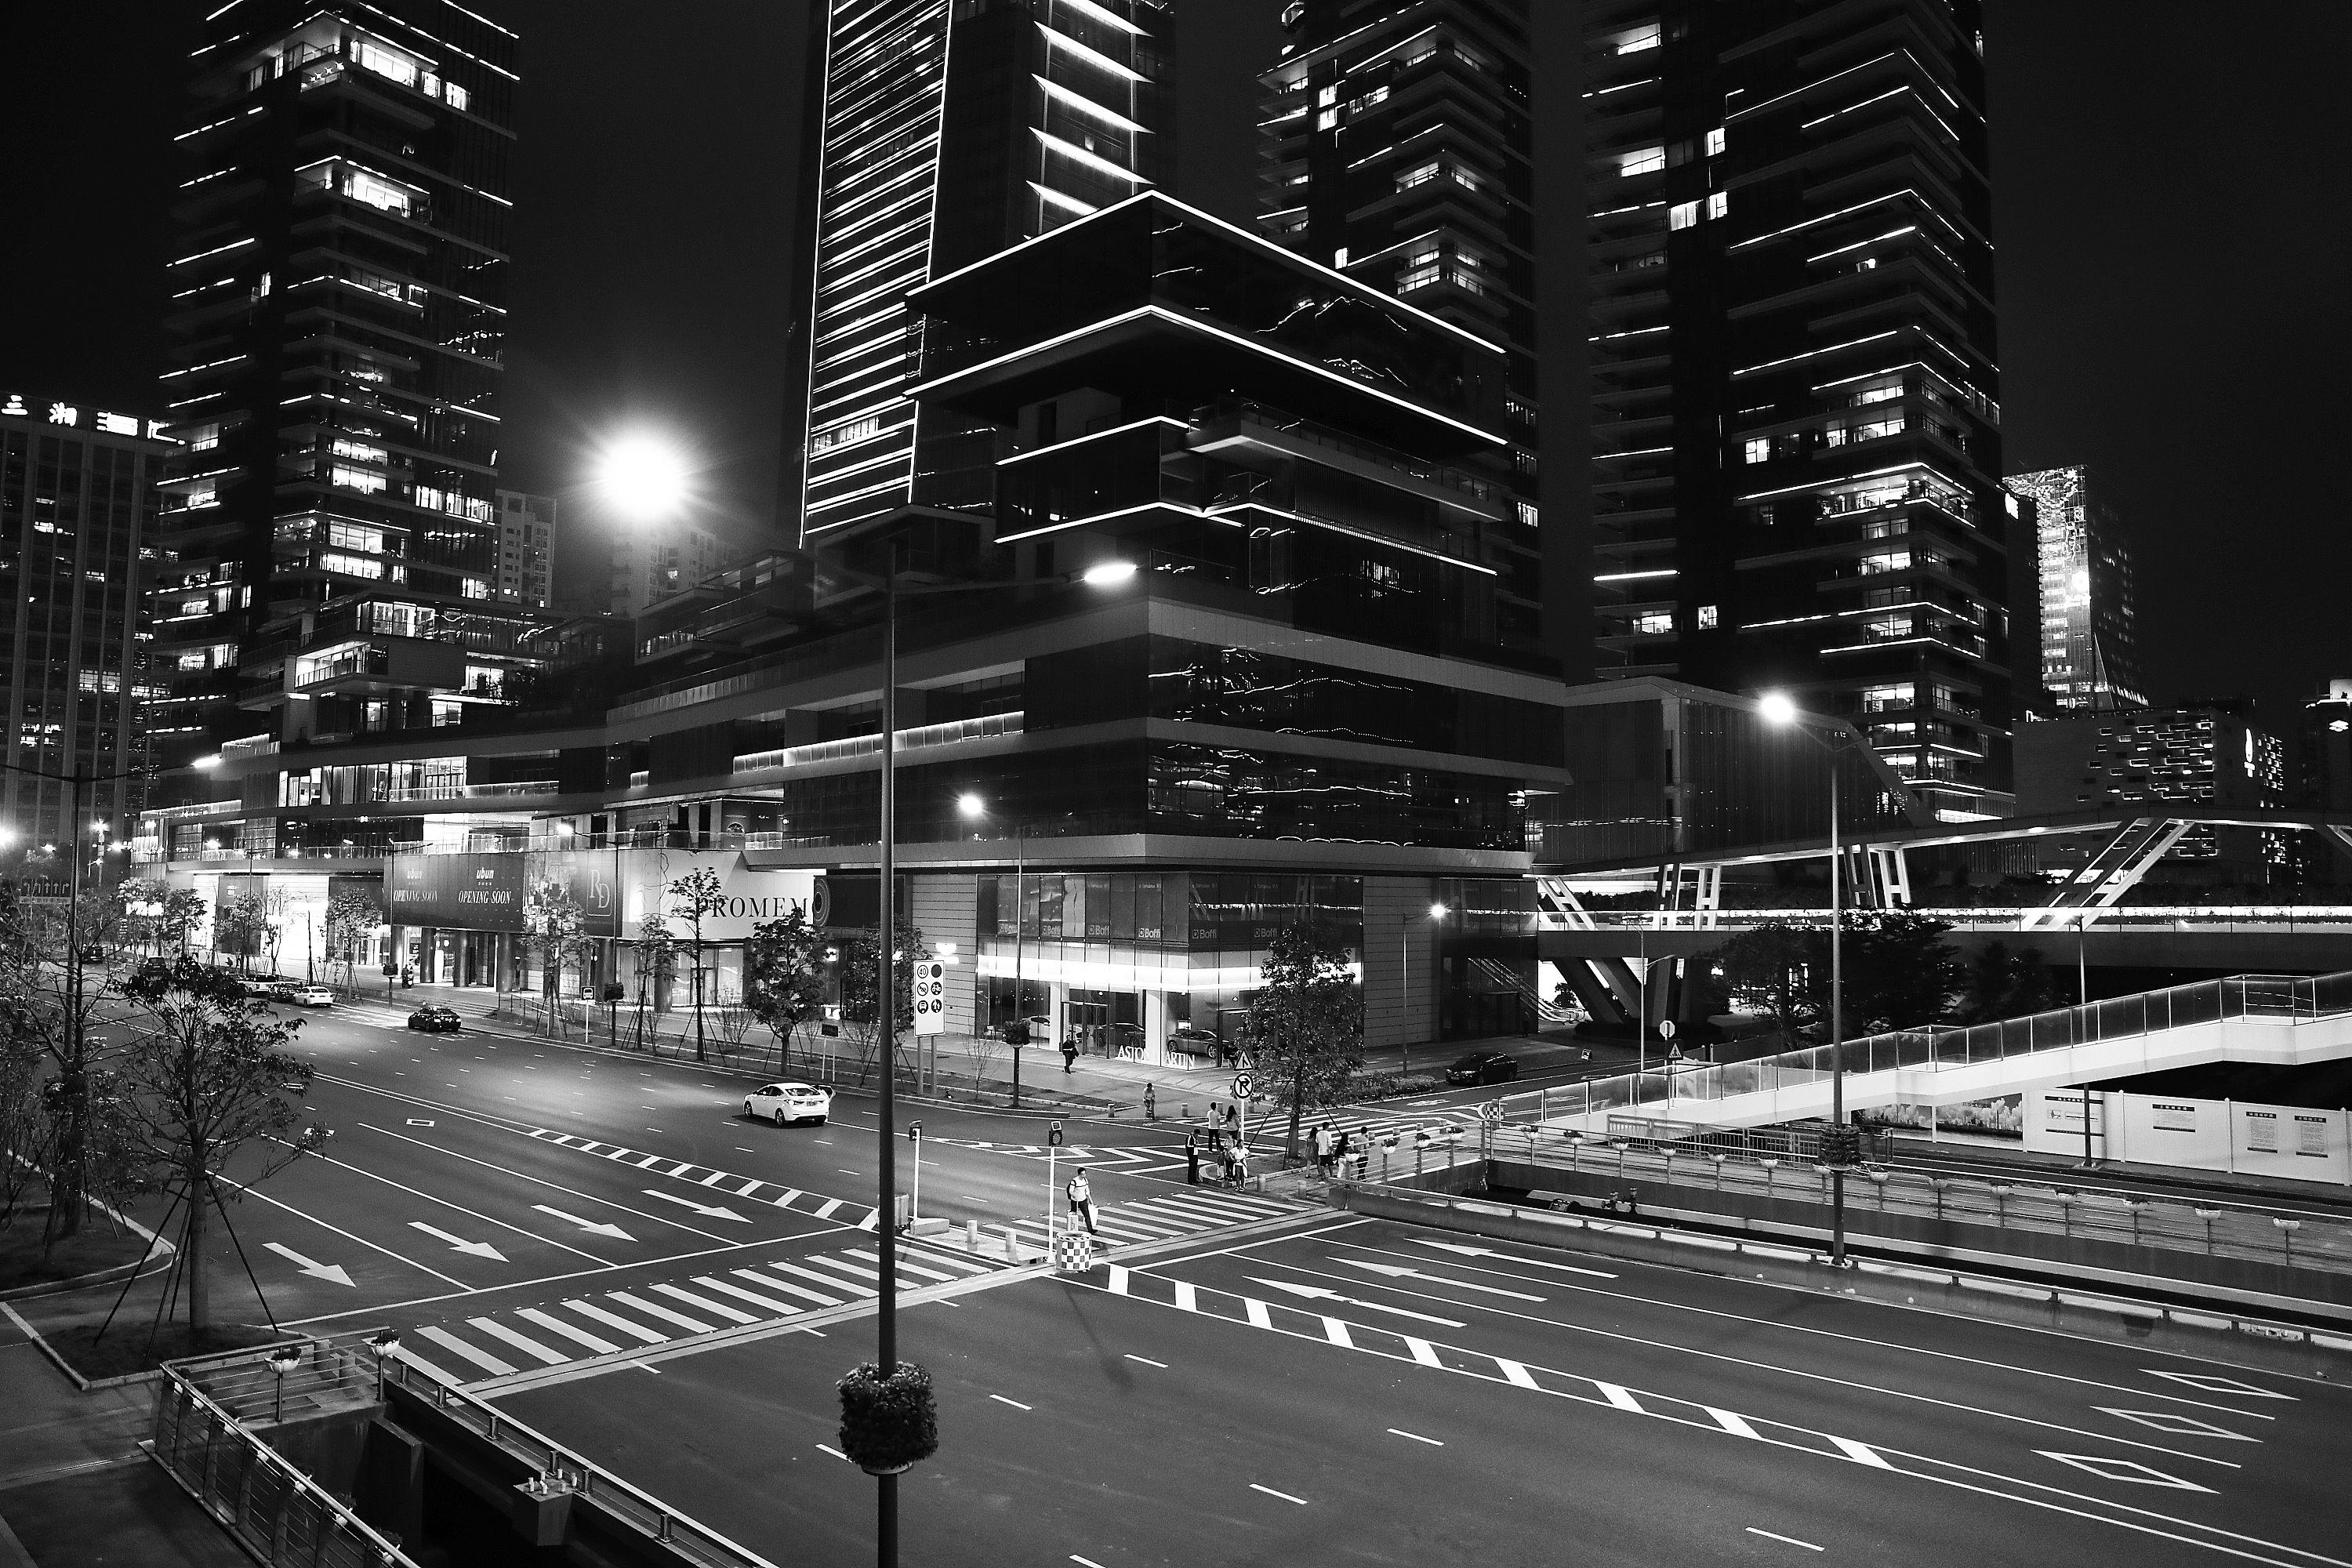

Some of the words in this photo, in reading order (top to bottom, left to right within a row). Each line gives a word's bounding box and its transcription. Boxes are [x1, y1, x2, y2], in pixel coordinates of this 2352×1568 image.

[477, 866, 494, 880] ubun
[394, 890, 419, 902] OPENING
[459, 890, 488, 903] OPENING
[491, 891, 512, 904] SOON
[697, 897, 814, 917] PROMEM
[1095, 924, 1110, 935] Boff
[1145, 928, 1160, 938] Boffi
[1200, 929, 1217, 938] Boffi
[1261, 927, 1277, 938] Boffi
[1160, 1051, 1195, 1067] ARTIN
